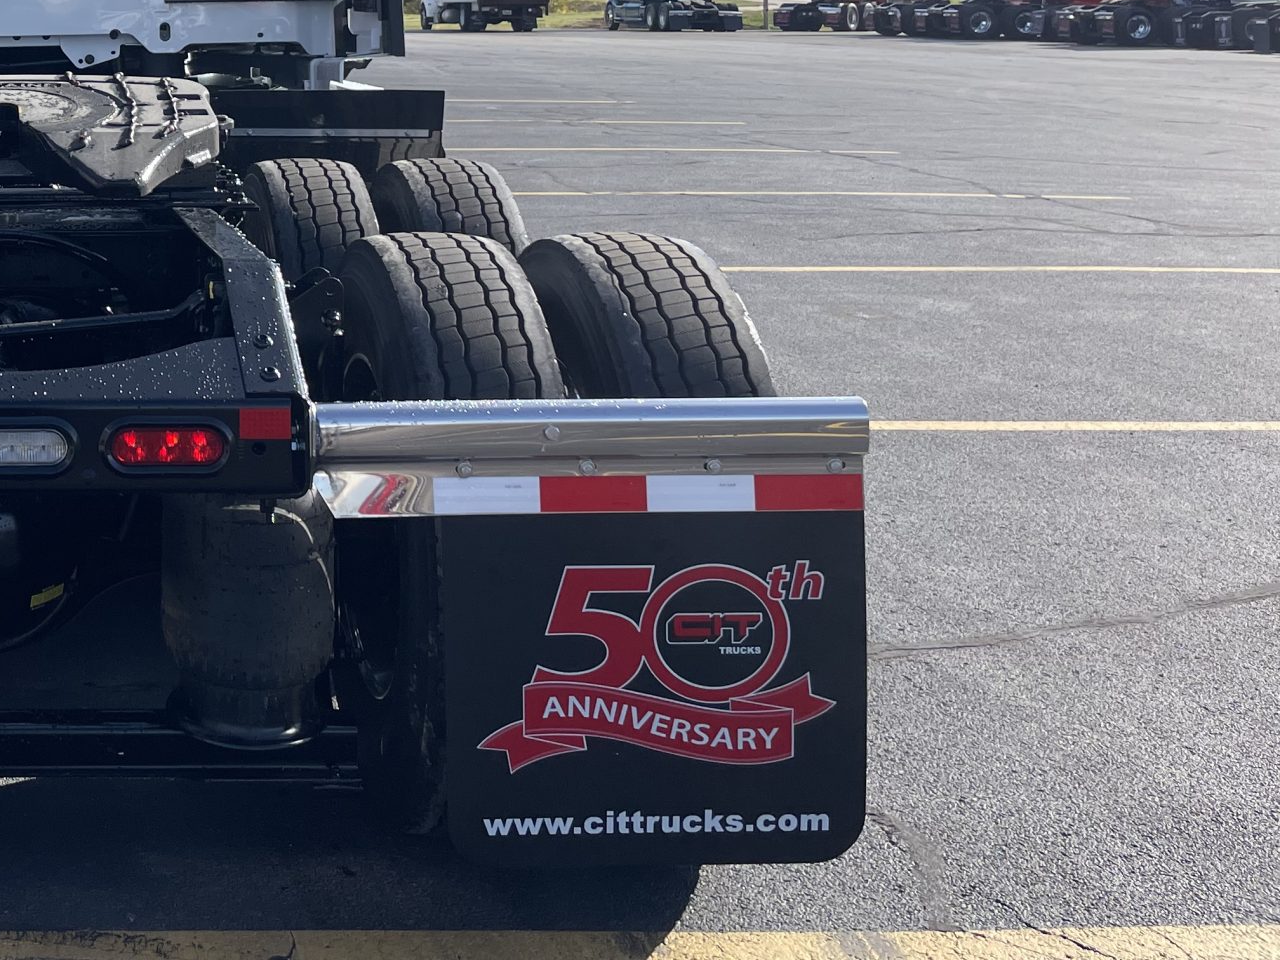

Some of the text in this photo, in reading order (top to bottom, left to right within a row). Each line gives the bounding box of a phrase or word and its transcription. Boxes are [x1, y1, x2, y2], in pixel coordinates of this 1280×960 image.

[530, 559, 825, 704] 50th
[665, 611, 763, 645] CIT
[719, 646, 762, 655] TRUCKS
[542, 695, 780, 750] ANNIVERSARY
[482, 809, 830, 837] www.cittrucks.com
